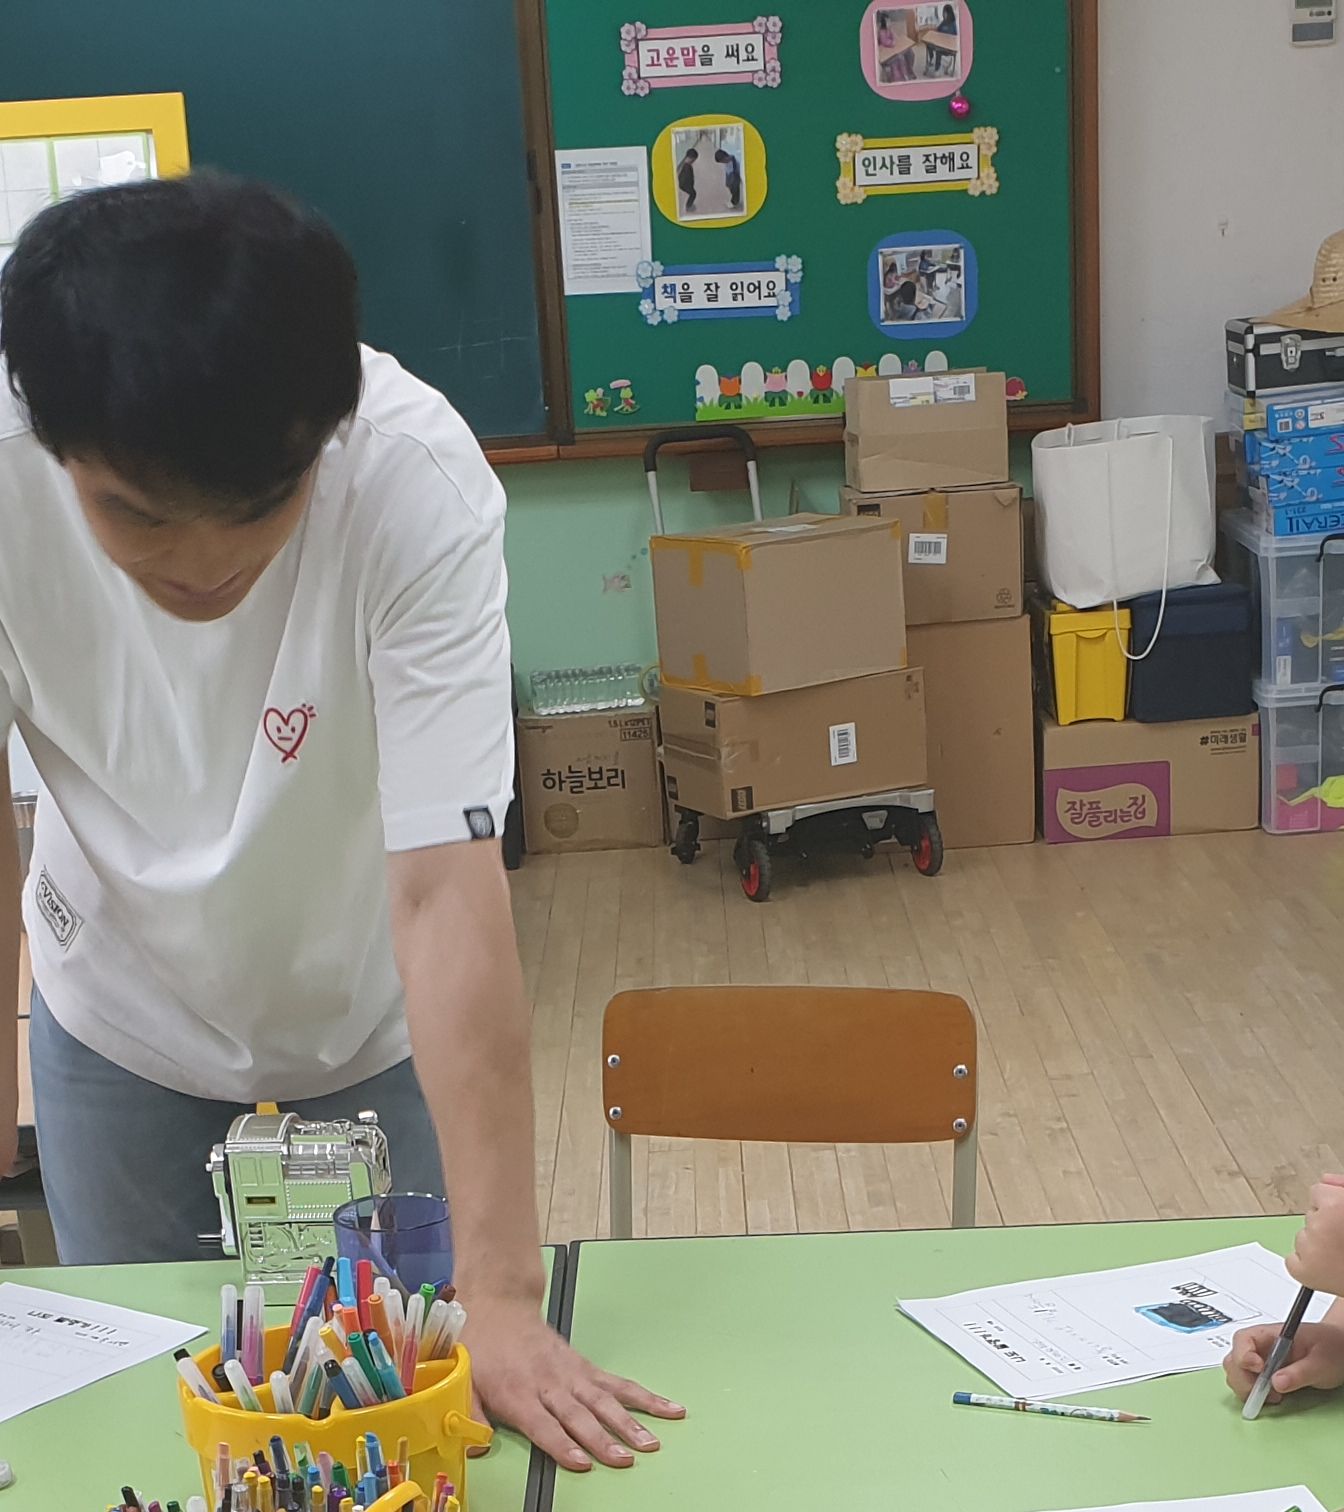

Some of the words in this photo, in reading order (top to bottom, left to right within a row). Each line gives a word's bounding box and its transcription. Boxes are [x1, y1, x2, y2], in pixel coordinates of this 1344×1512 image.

[646, 44, 714, 68] 고운말을
[724, 43, 758, 65] 써요
[861, 154, 912, 177] 인사를
[922, 151, 973, 174] 잘해요
[661, 282, 694, 303] 책을
[703, 282, 720, 302] 잘
[729, 280, 777, 301] 읽어요
[541, 765, 626, 795] 하늘보리
[1064, 794, 1146, 828] 잘풀리는집
[41, 882, 69, 927] VISION
